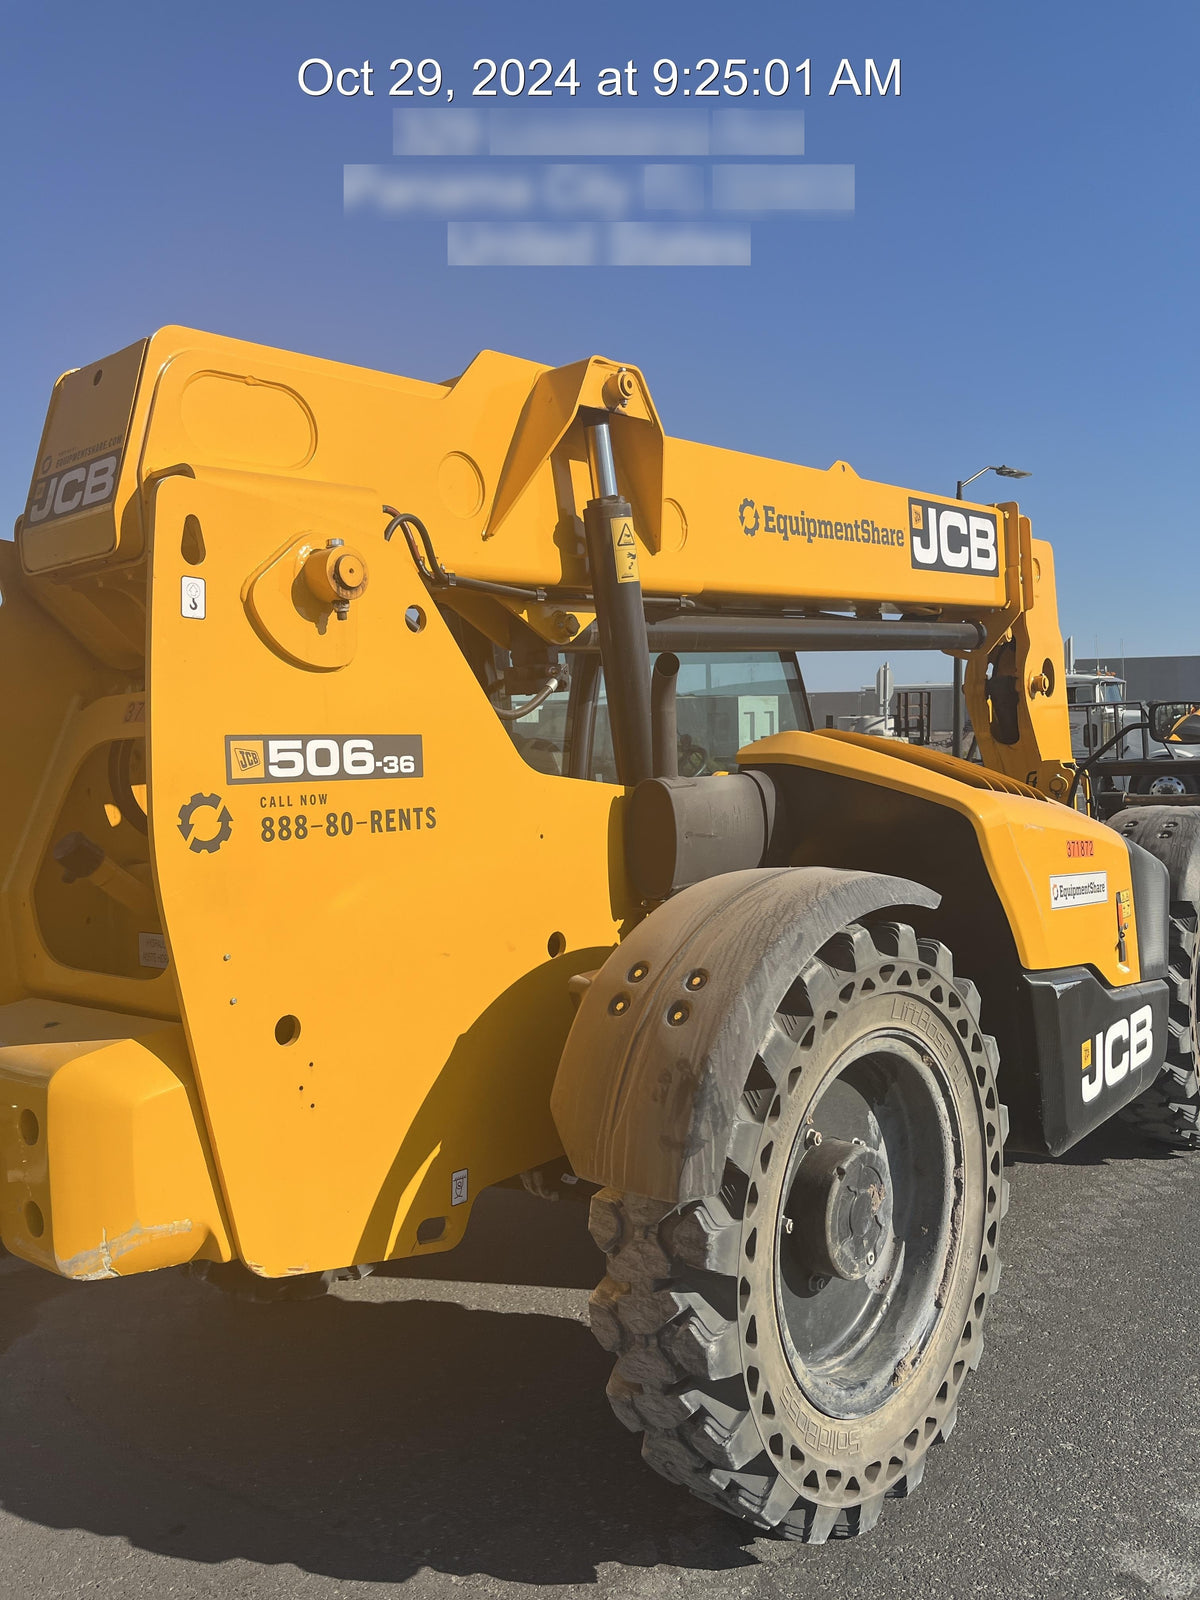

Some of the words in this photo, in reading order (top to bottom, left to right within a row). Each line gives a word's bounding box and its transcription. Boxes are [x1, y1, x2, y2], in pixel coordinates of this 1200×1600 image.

[30, 456, 117, 522] JCB
[763, 505, 905, 547] EquipmentShare
[912, 507, 997, 572] JCB
[239, 750, 259, 769] JCB
[268, 739, 415, 778] 506-36
[260, 796, 293, 808] CALL
[300, 794, 328, 806] NOW
[261, 807, 437, 842] 888-80-RENTS
[1066, 841, 1094, 857] 371872
[1060, 882, 1105, 899] EquipmentShare
[1082, 1004, 1153, 1103] JCB
